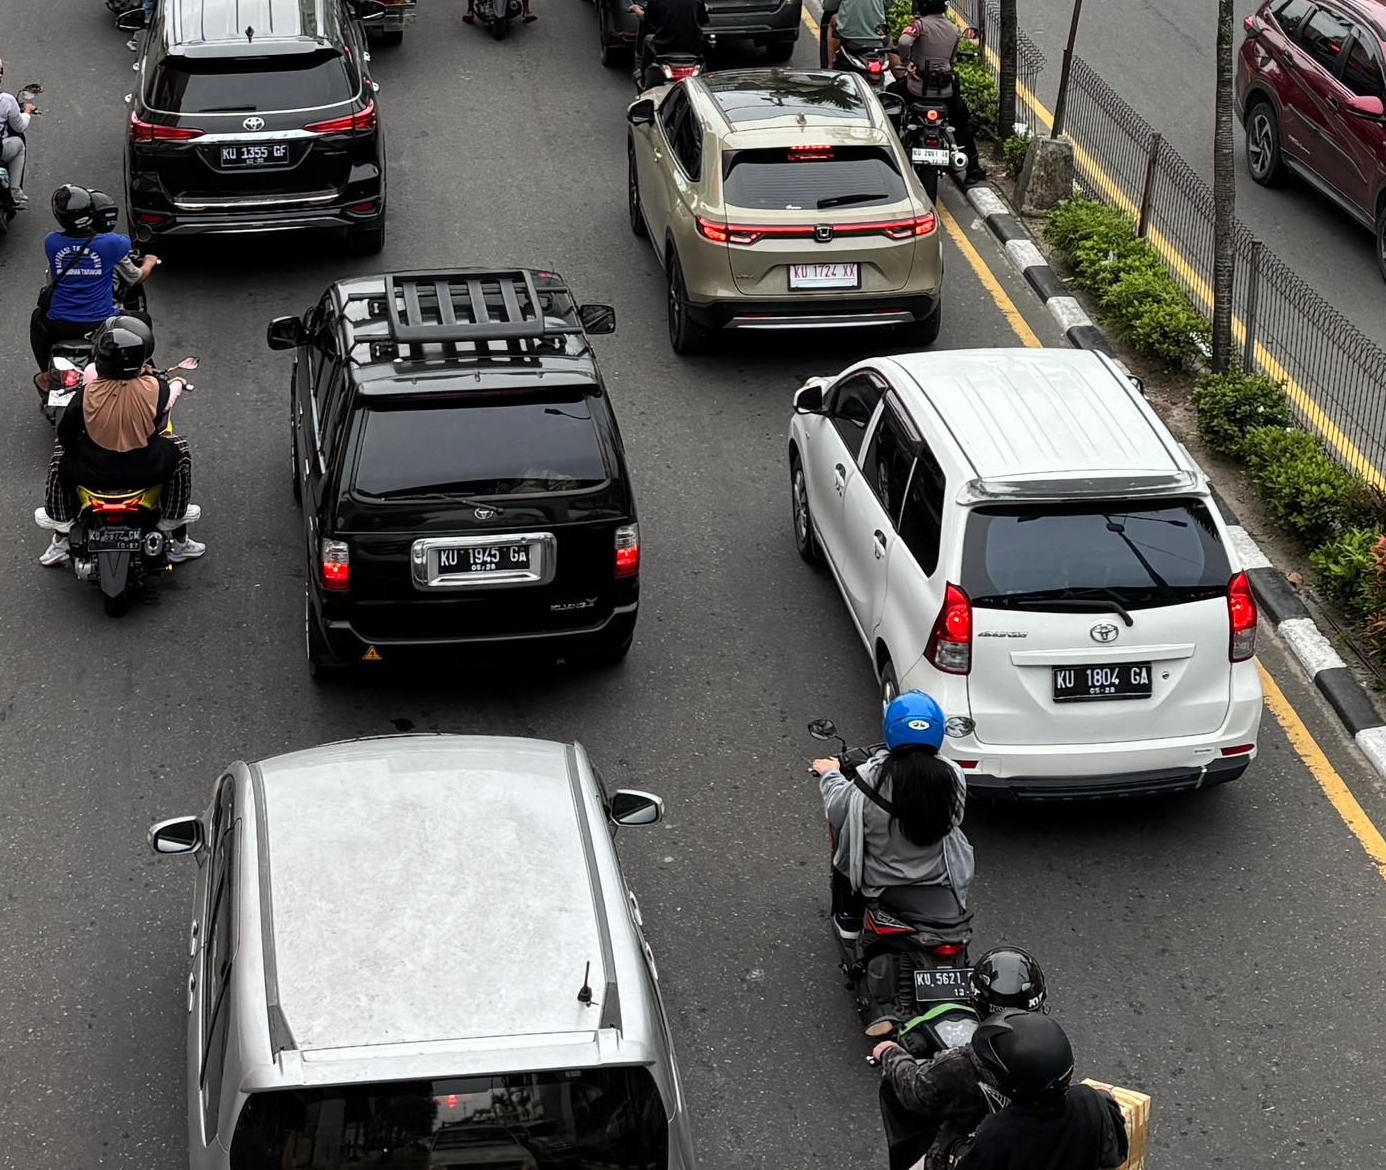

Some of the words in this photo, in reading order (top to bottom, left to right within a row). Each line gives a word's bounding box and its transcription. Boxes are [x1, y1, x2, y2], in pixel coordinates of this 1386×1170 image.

[223, 148, 237, 160] KU
[241, 147, 268, 159] 1355
[793, 266, 807, 279] KU
[814, 265, 838, 278] 1724
[843, 264, 855, 277] XX
[441, 550, 458, 567] KU
[469, 547, 501, 564] 1945
[510, 546, 528, 563] GA
[1057, 672, 1075, 689] KU
[1086, 669, 1119, 686] 1804
[1131, 667, 1149, 684] GA
